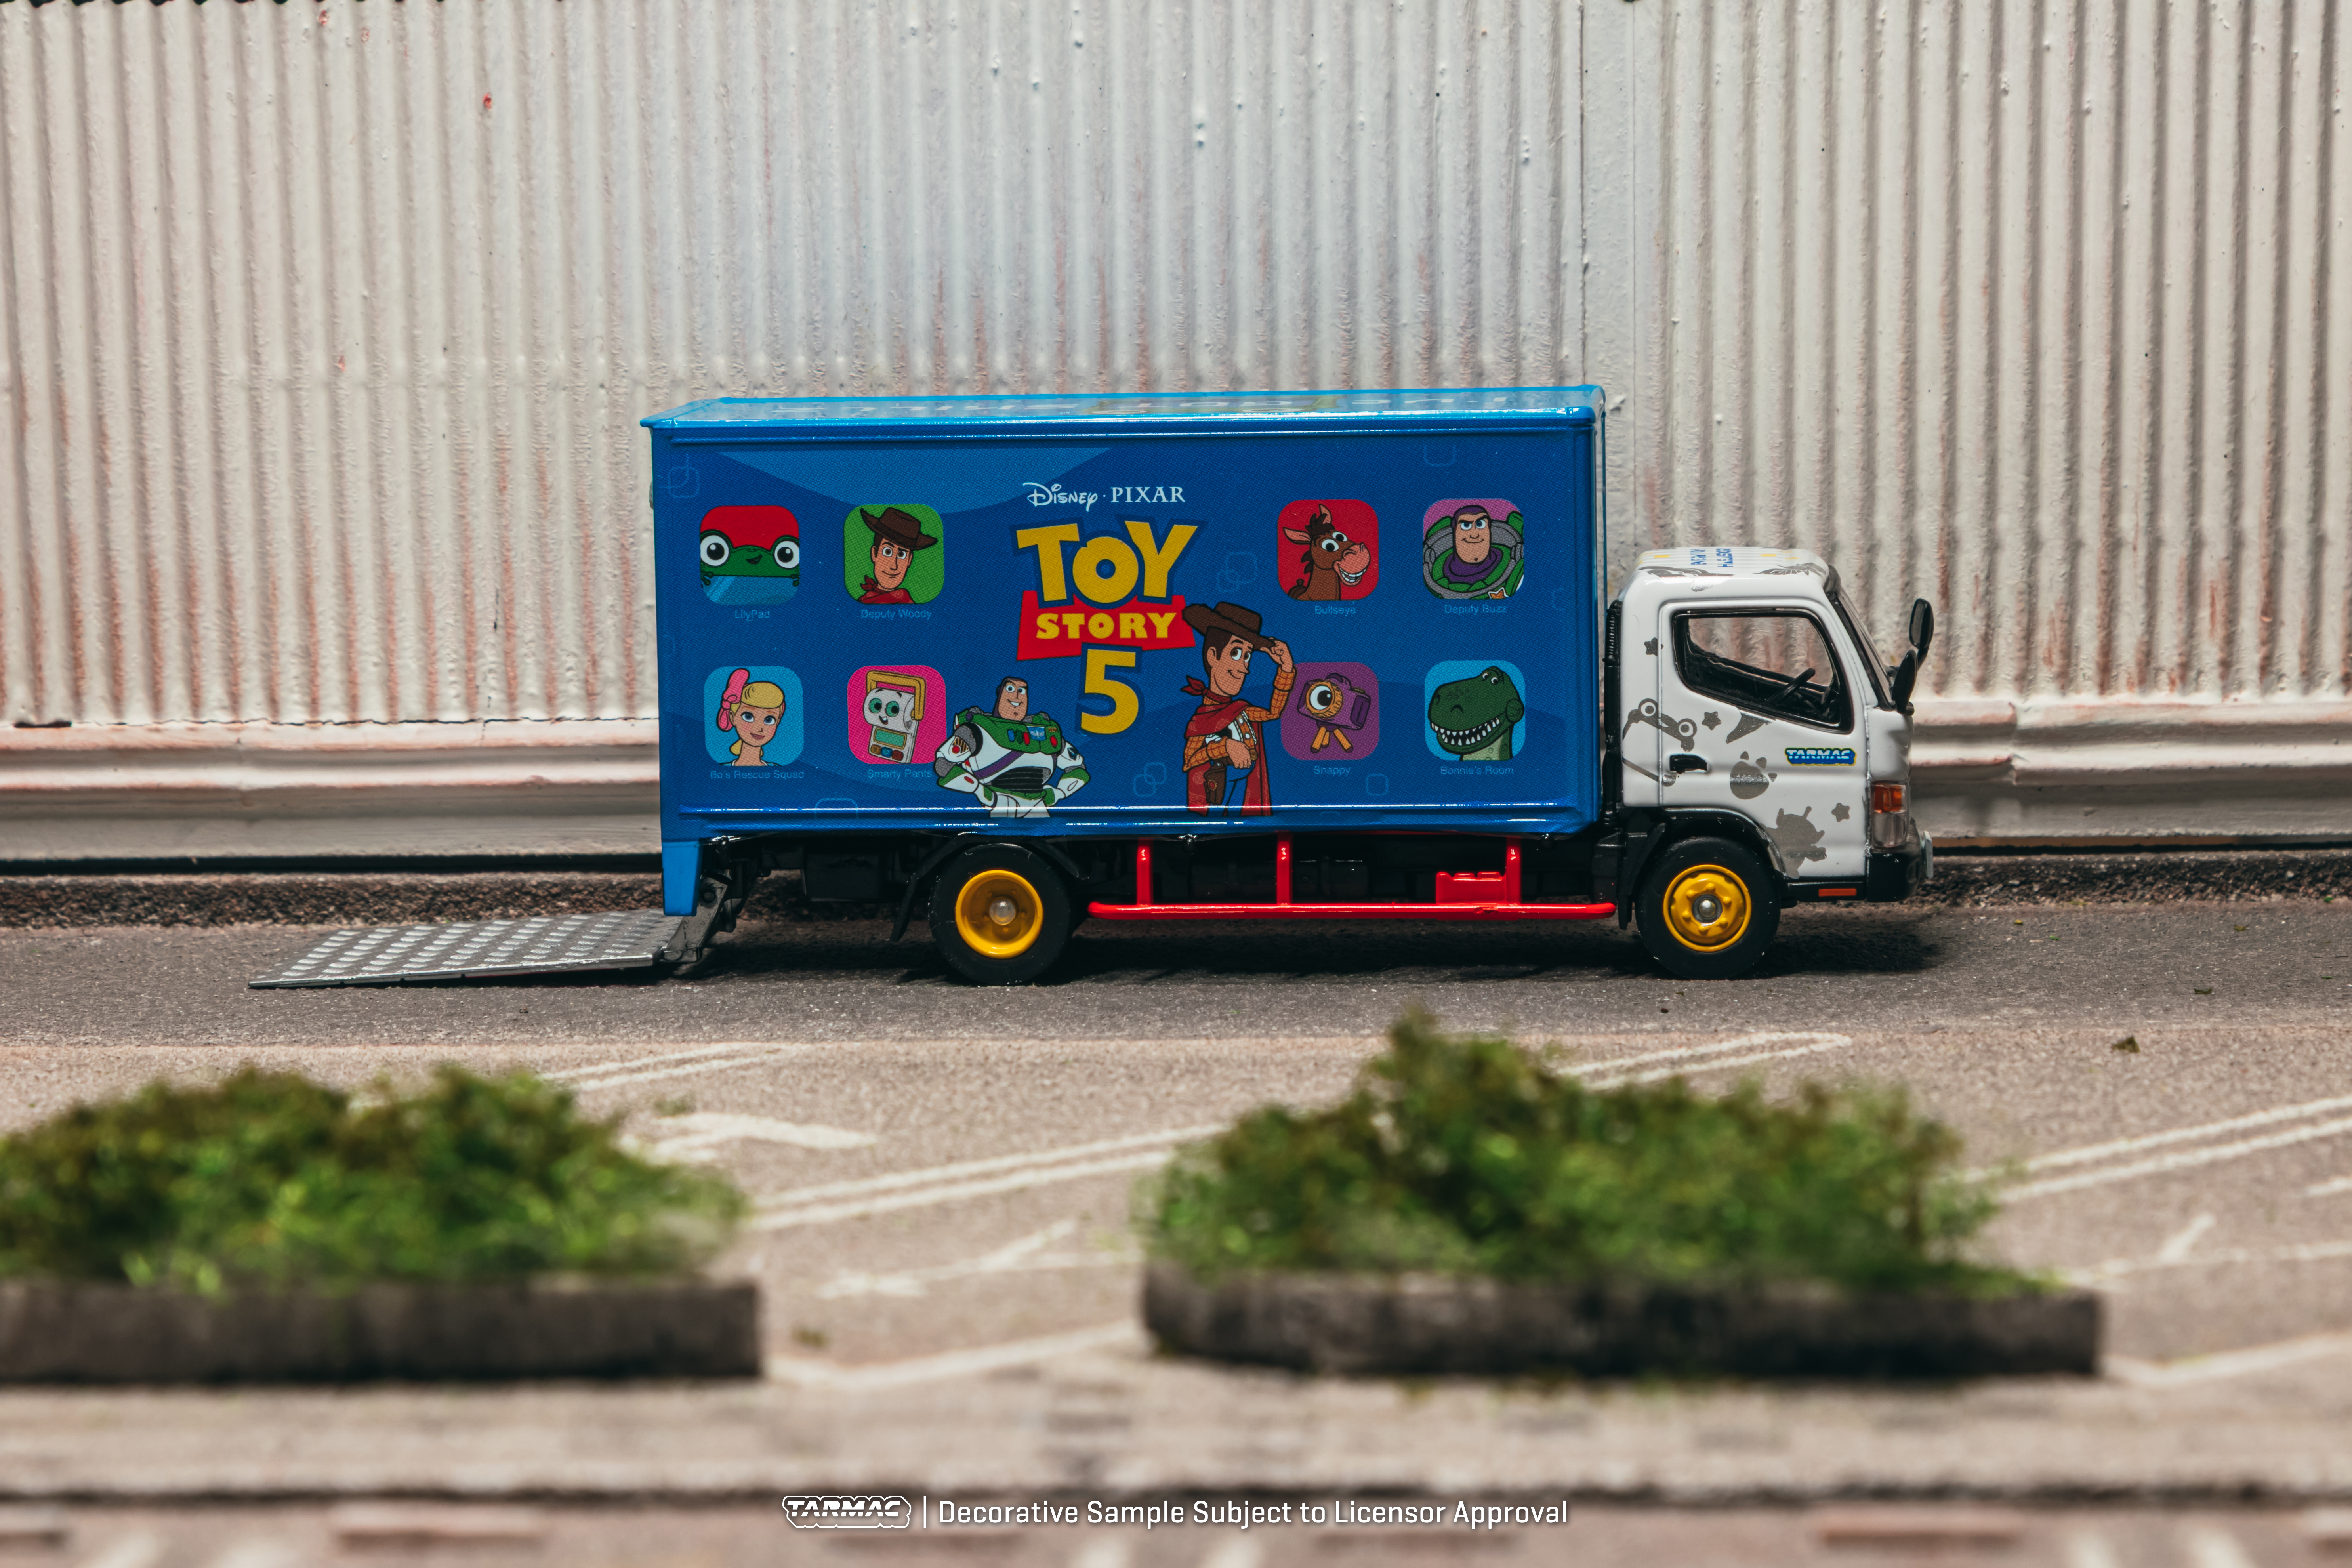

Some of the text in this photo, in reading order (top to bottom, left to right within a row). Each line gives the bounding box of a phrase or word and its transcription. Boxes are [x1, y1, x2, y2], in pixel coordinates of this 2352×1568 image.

[1022, 482, 1186, 512] Disney PIXAR
[1016, 520, 1198, 604] TOY
[734, 609, 770, 622] LilyPad
[861, 609, 932, 620] Deputy Woody
[1314, 605, 1356, 616] Bullseye
[1444, 604, 1507, 616] Deputy Buzz
[1036, 612, 1177, 640] STORY
[1081, 648, 1139, 734] 5
[1786, 749, 1851, 759] TARMAC
[710, 769, 805, 780] Bo's Rescue Squad
[867, 769, 933, 780] Smarty Pants
[1313, 765, 1351, 776] Snappy
[1440, 765, 1514, 775] Bonnie's Room
